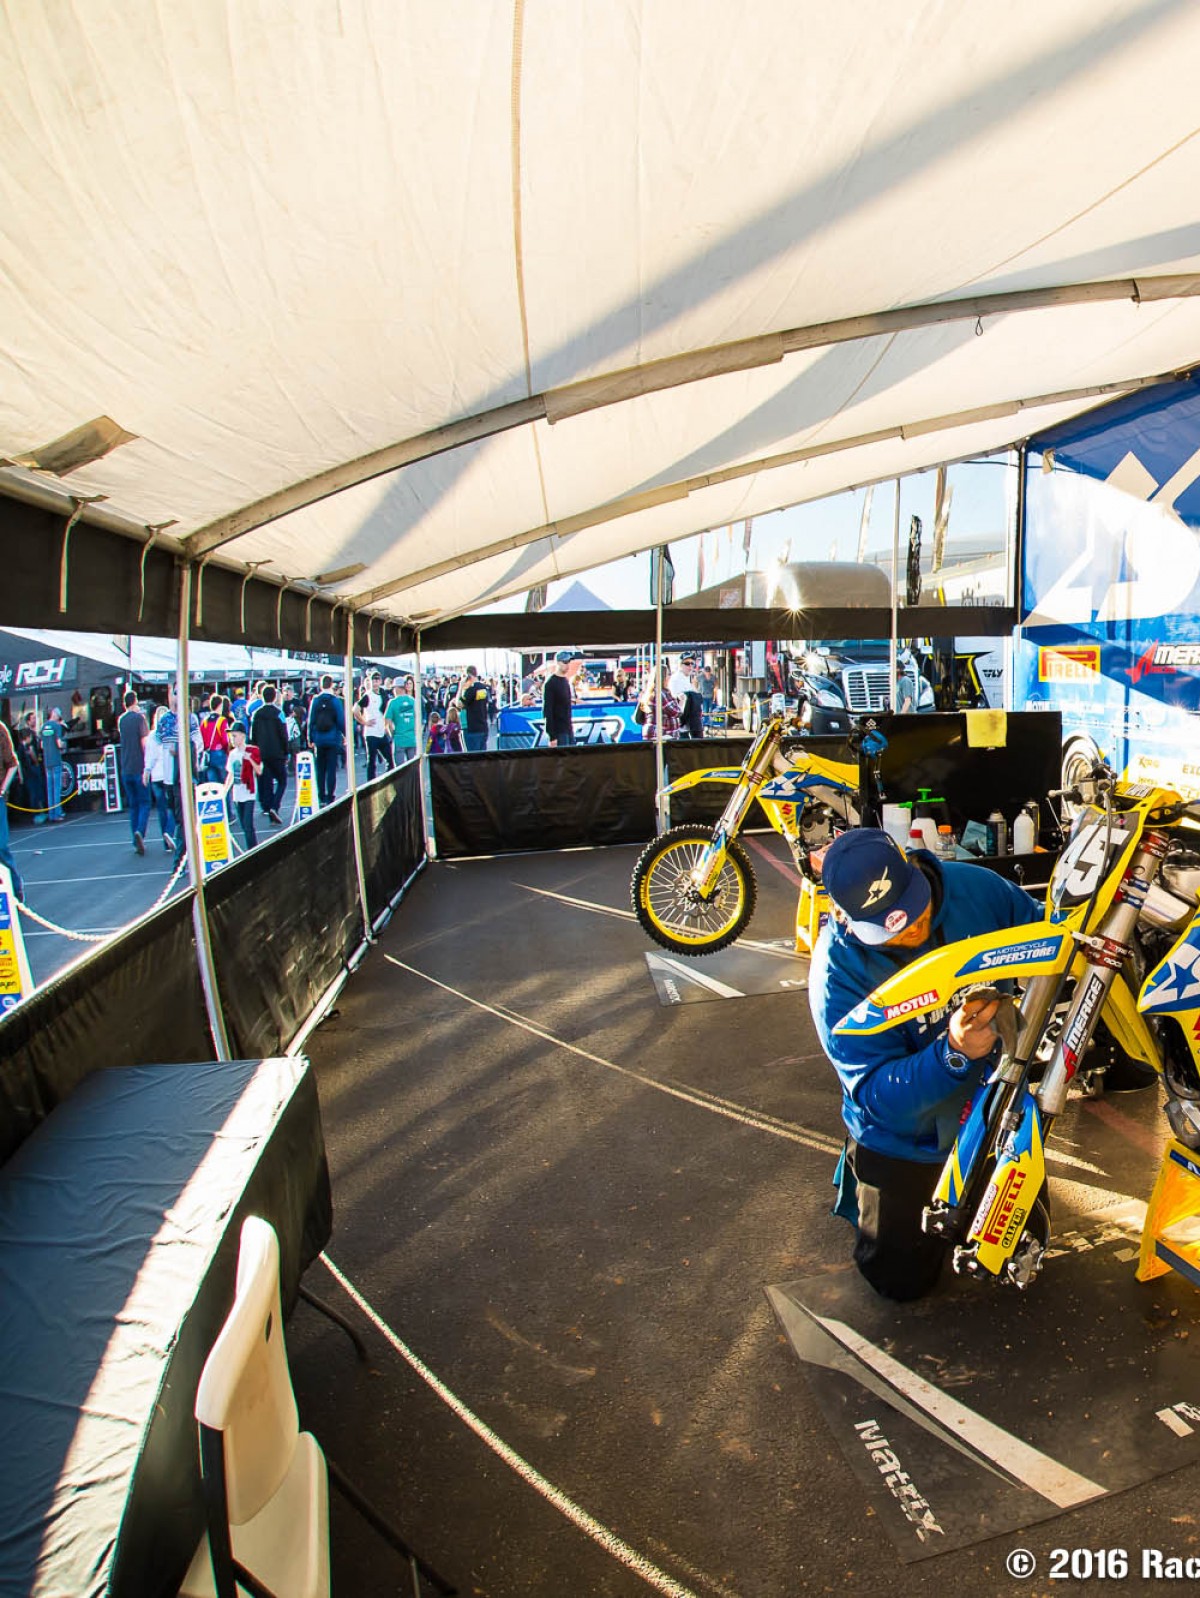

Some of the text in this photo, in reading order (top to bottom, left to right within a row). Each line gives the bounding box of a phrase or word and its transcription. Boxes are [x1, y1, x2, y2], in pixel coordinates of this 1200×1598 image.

[15, 658, 67, 687] RCH
[1042, 651, 1097, 679] PIRELLI
[997, 941, 1048, 954] MOTORCYCLE
[886, 991, 938, 1020] MOTUL
[1067, 977, 1103, 1049] MERGE
[983, 1168, 1026, 1245] PIRELLI
